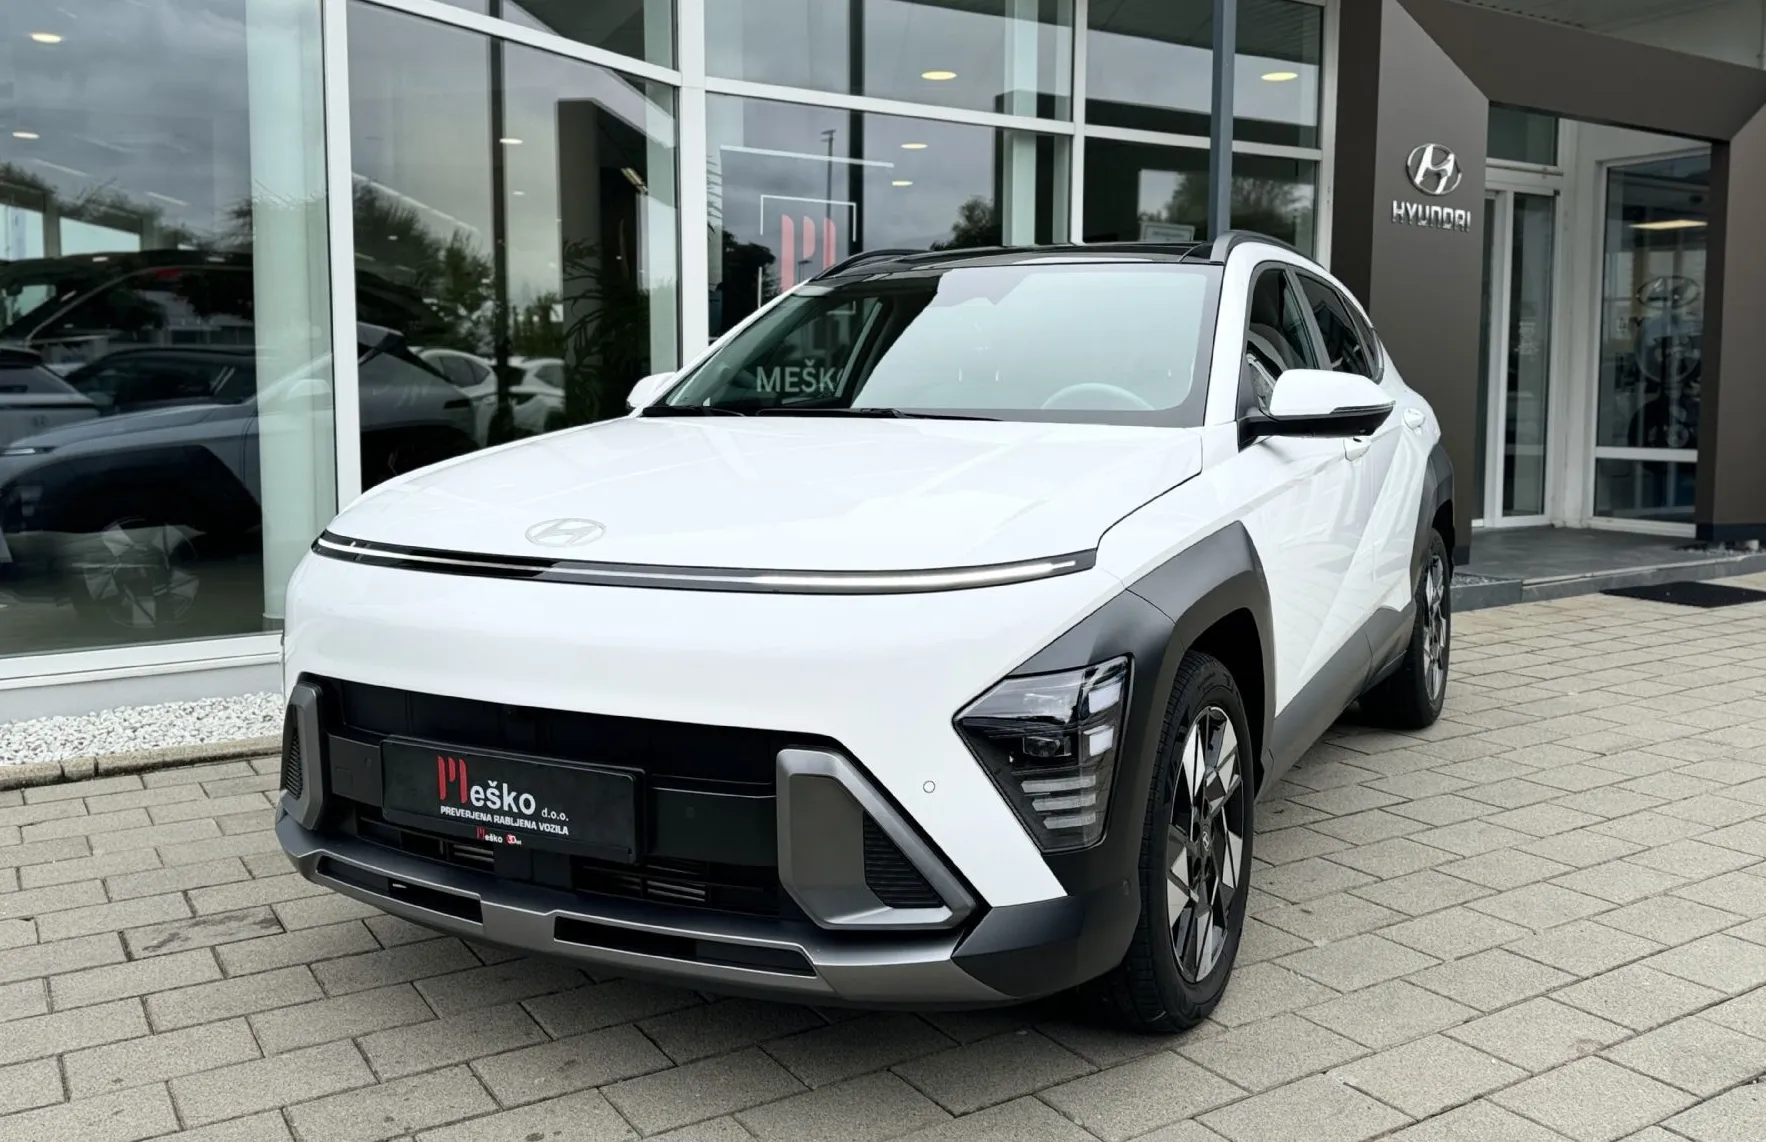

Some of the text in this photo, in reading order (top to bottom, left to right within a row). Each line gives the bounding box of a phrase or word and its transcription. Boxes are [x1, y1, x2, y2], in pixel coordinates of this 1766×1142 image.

[1392, 200, 1471, 232] HYUNDAI
[756, 358, 843, 393] MEŠK
[440, 805, 569, 835] PREVERJENA RABLJENA VOZILA
[541, 807, 569, 821] d.o.o.
